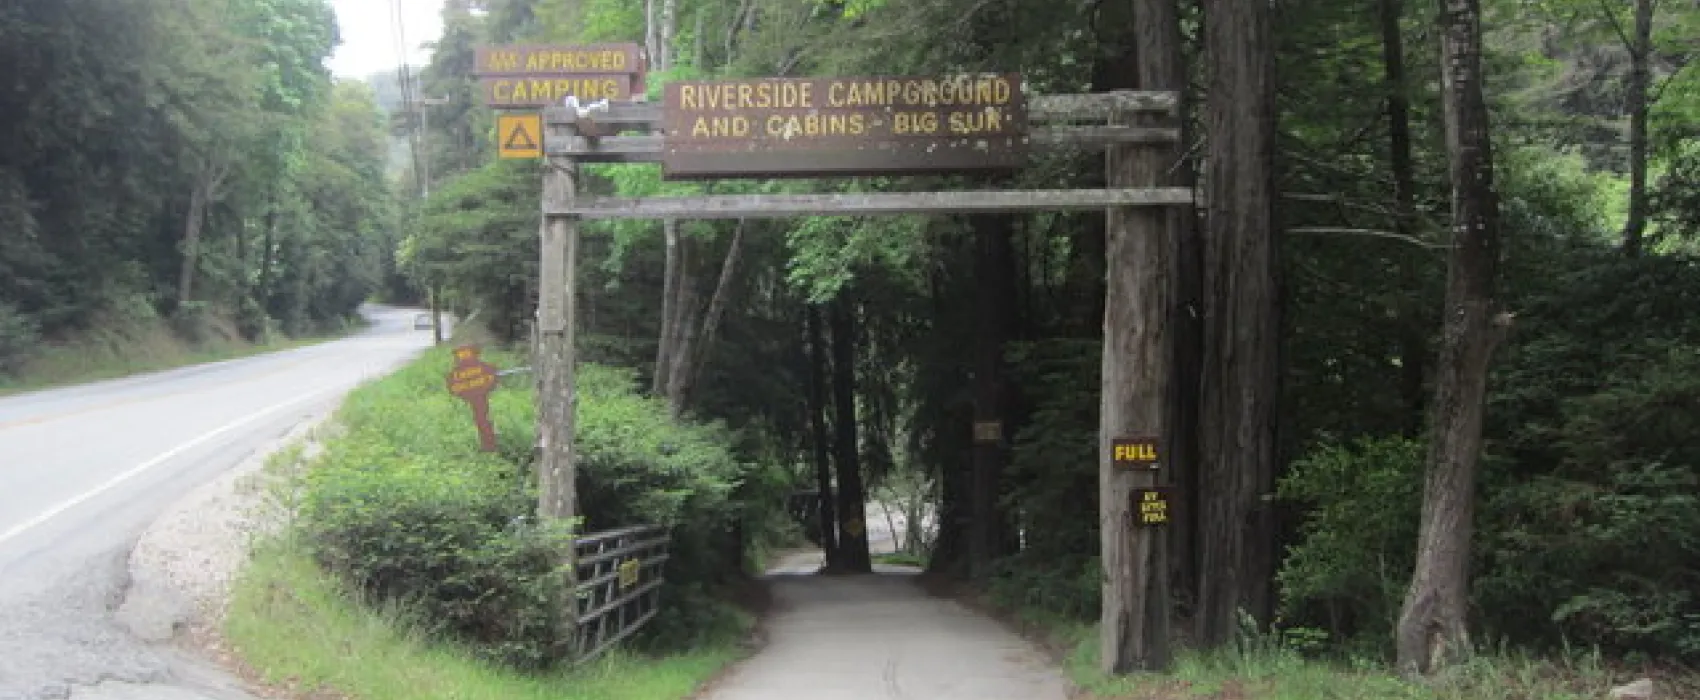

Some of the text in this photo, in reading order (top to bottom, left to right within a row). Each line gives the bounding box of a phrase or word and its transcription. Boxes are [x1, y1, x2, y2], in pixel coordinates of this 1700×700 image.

[526, 50, 625, 69] APPROVED
[493, 79, 619, 101] CAMPING
[680, 77, 1010, 109] RIVERSIDE CAMPGROUND
[692, 115, 750, 138] AND
[767, 113, 864, 139] CABINS
[893, 111, 937, 133] BIG
[949, 109, 1002, 134] SUR
[1115, 444, 1156, 460] FULL
